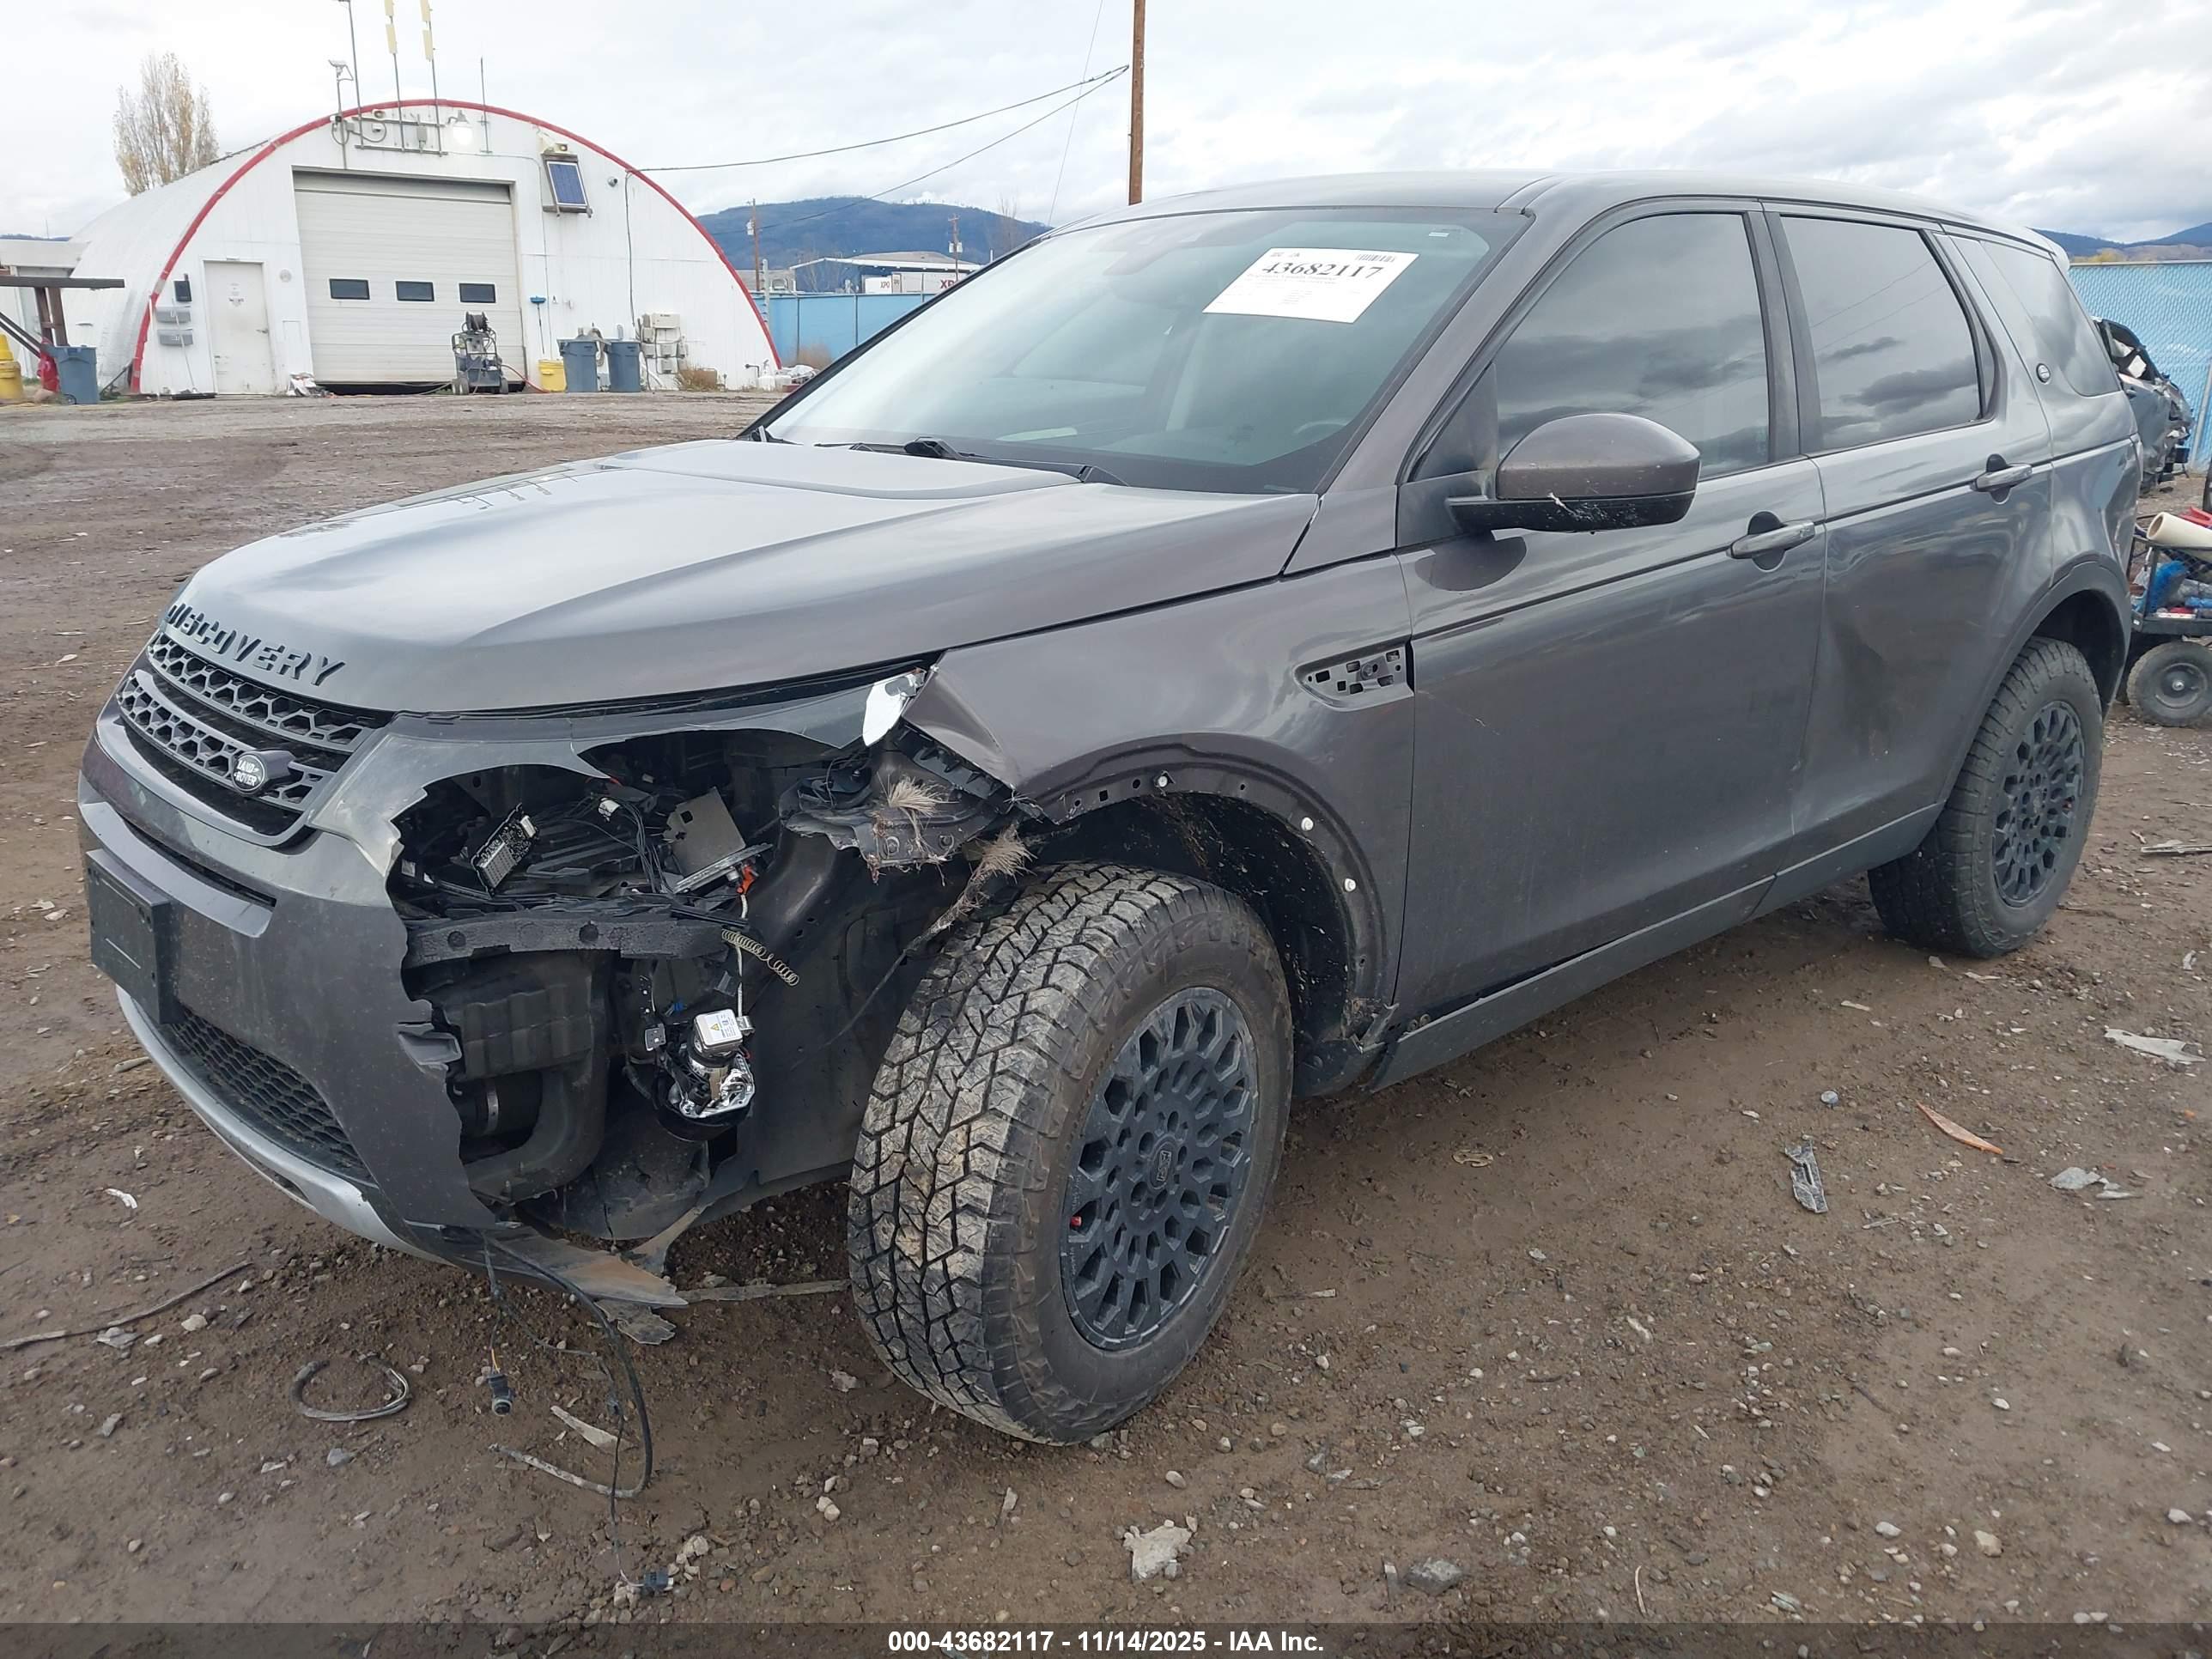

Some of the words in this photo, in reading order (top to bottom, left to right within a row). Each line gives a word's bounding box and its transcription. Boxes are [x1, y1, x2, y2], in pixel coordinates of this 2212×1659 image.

[1262, 261, 1384, 279] 43682117
[167, 603, 346, 687] DISCOVERY
[236, 760, 256, 773] LAND
[235, 771, 258, 787] ROVER
